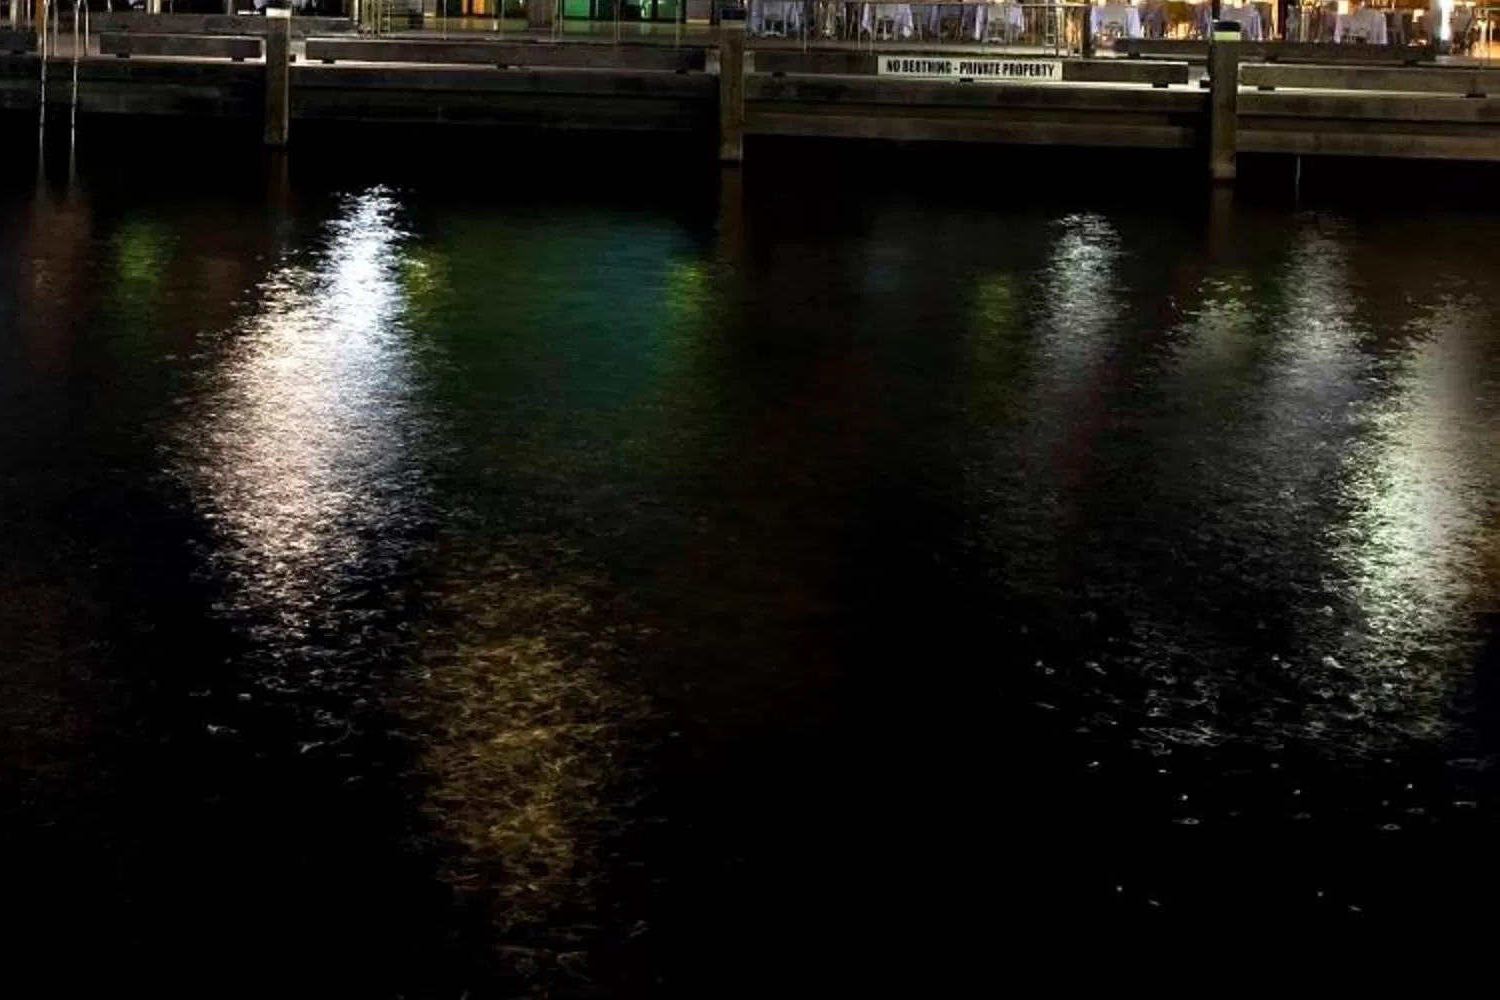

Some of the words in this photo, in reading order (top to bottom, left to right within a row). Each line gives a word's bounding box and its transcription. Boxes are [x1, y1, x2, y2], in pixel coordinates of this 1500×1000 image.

[886, 59, 901, 73] NO
[902, 59, 952, 74] BERTHING
[959, 61, 1001, 75] PRIVATE
[1002, 63, 1055, 77] PROPERTY
